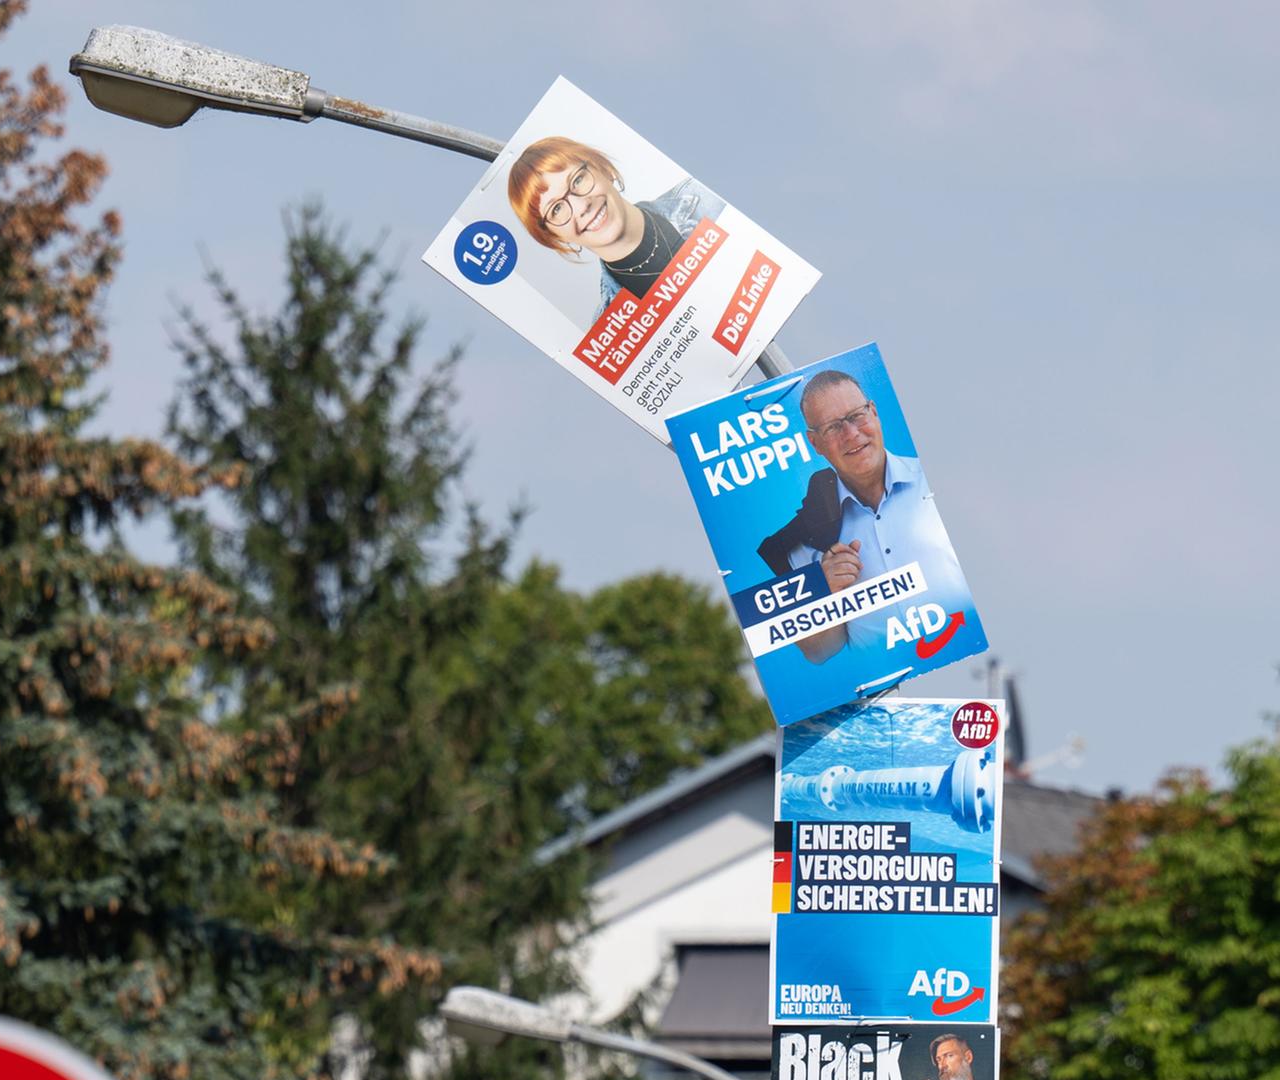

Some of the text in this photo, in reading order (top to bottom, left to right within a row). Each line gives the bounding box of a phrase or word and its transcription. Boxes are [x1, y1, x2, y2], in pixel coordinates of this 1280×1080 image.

[463, 232, 498, 266] 1.9.
[481, 240, 506, 275] Landtags-
[494, 253, 509, 272] wahl
[598, 229, 720, 374] Tändler-Walenta
[721, 263, 774, 345] Die Linke
[581, 300, 638, 364] Marika
[622, 305, 697, 397] Demokratie retten
[636, 325, 700, 408] geht nur radikal
[646, 372, 684, 415] SOZIAL!
[689, 403, 789, 463] LARS
[703, 432, 811, 497] KUPPI
[754, 573, 812, 615] GEZ
[769, 571, 916, 645] ABSCHAFFEN!
[886, 603, 947, 650] AfD
[956, 709, 995, 722] AM 1.9.
[958, 723, 992, 740] AfD!
[840, 781, 932, 797] NORD STREAM 2
[798, 824, 907, 850] ENERGIE-
[798, 855, 954, 882] VERSORGUNG
[796, 885, 994, 913] SICHERSTELLEN!
[780, 984, 842, 1003] EUROPA
[908, 968, 969, 997] AfD
[780, 1003, 852, 1016] NEU DENKEN!
